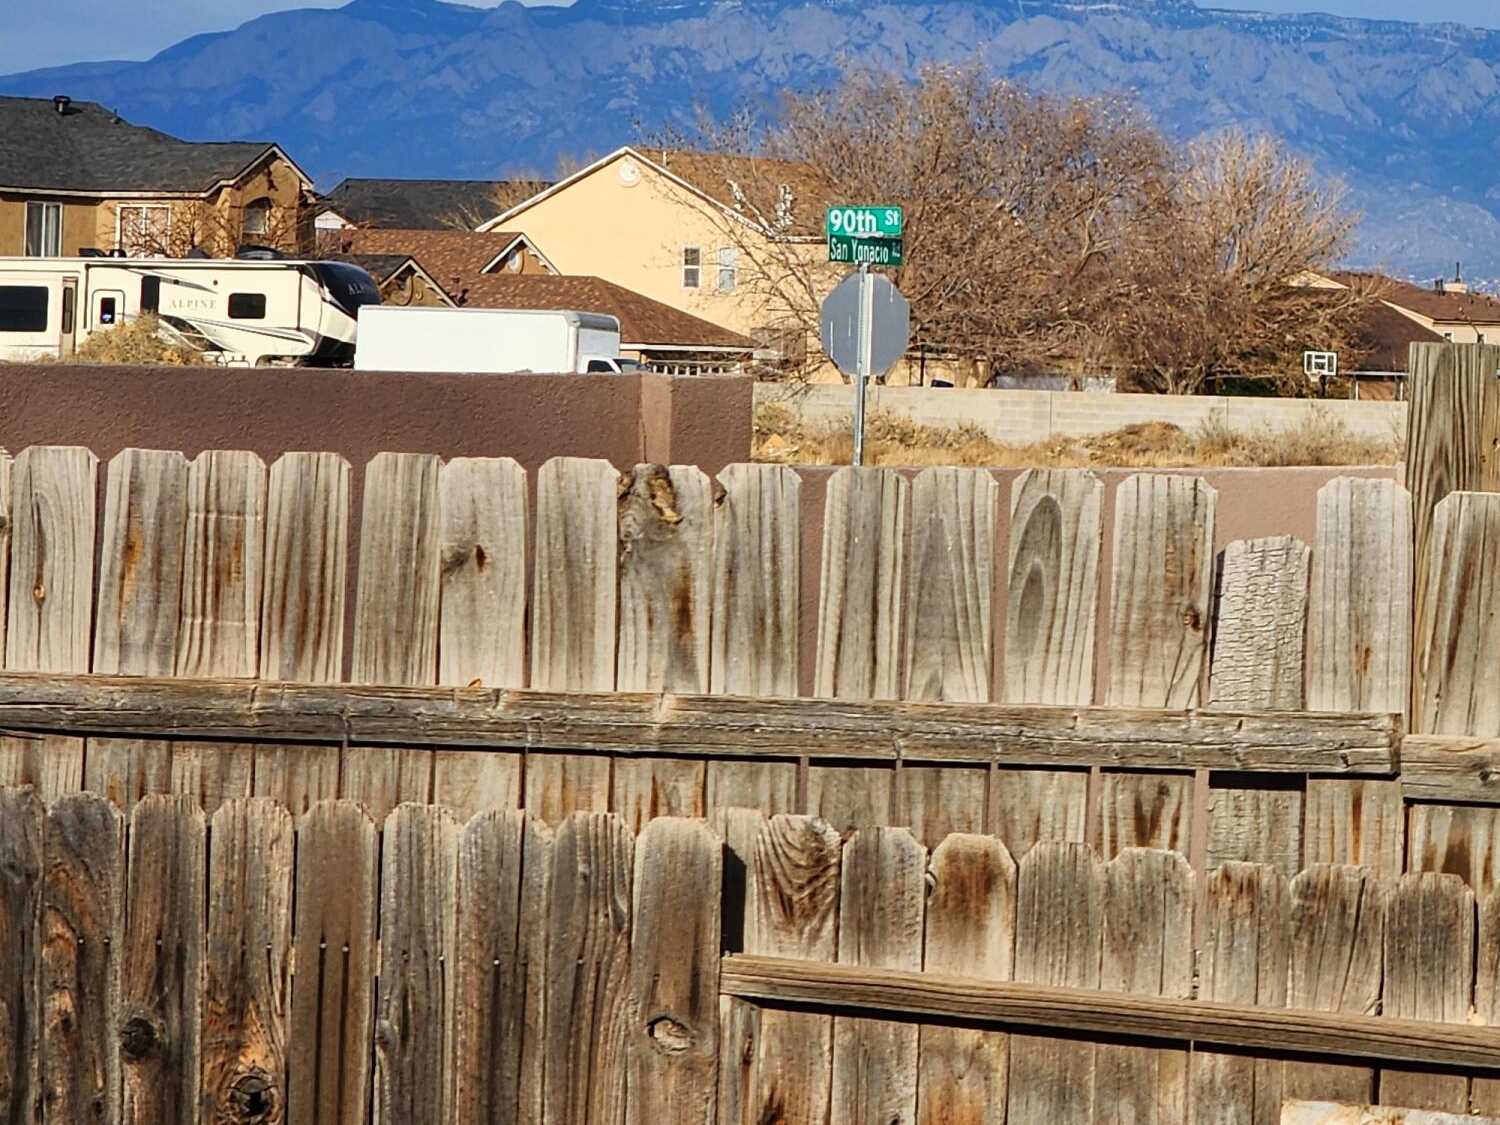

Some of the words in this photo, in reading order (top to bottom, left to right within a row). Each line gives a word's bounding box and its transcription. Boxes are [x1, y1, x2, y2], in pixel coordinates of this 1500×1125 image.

[830, 209, 877, 232] 90th
[884, 209, 899, 226] St
[830, 237, 848, 260] San
[169, 299, 217, 309] ALPINE
